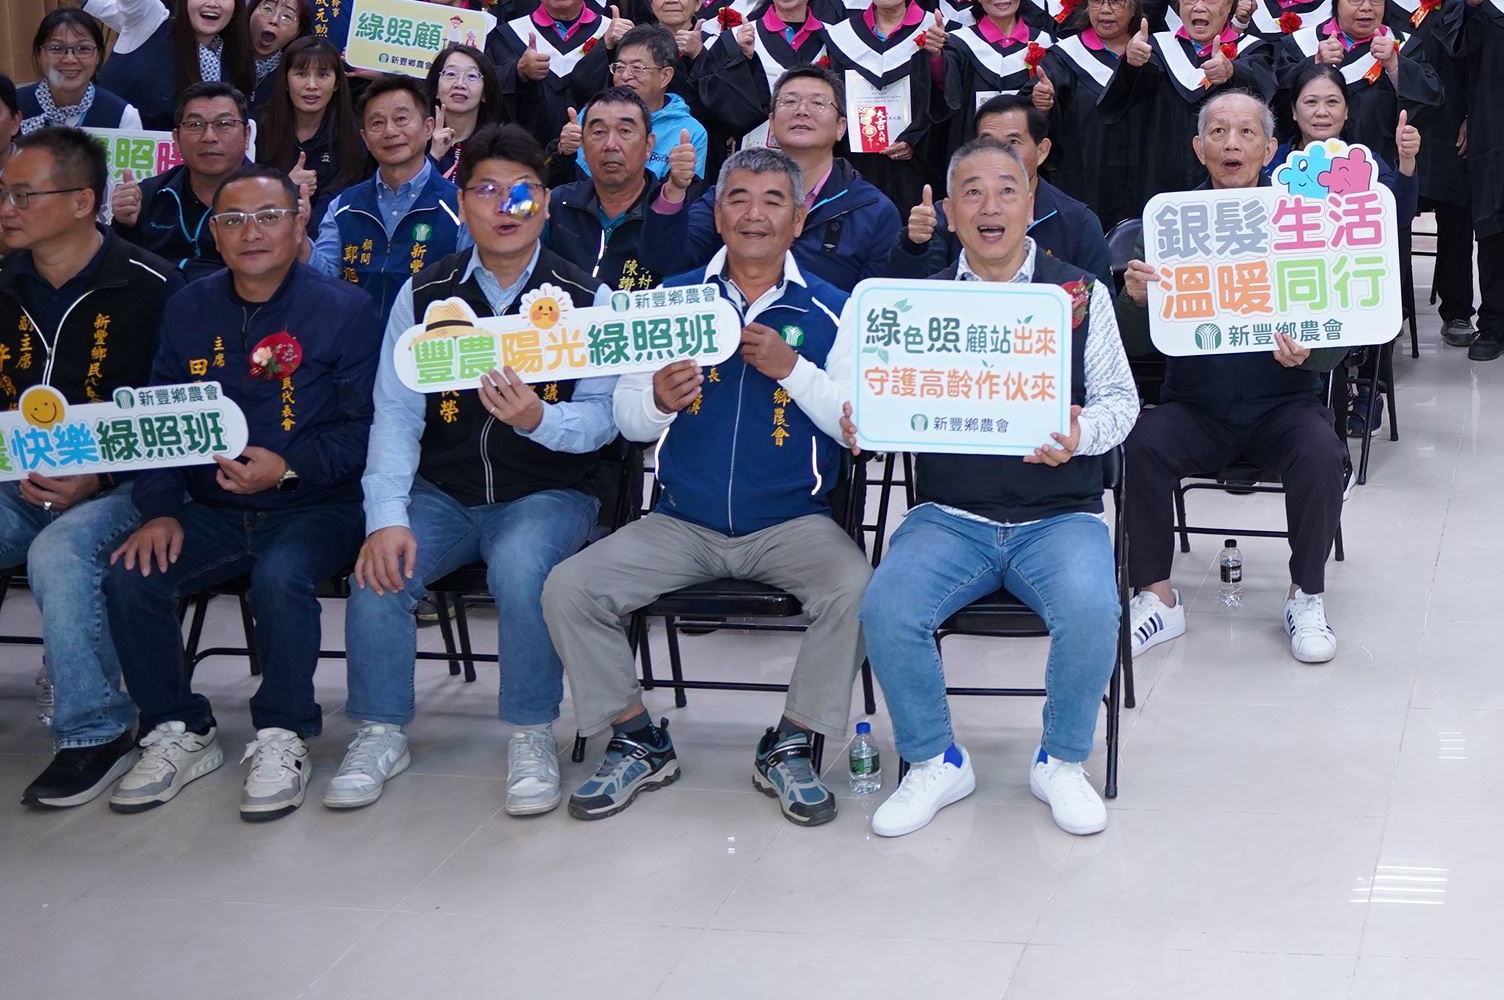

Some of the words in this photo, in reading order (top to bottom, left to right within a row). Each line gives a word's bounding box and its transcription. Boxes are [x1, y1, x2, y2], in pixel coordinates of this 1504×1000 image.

[355, 12, 444, 51] 綠照顧
[1154, 192, 1383, 259] 銀髮生活
[634, 286, 717, 310] 新豐鄉農會
[1158, 256, 1387, 319] 溫暖同行
[412, 312, 719, 386] 豐農陽光綠照班
[865, 306, 1057, 356] 綠色照顧站出來
[1227, 318, 1344, 348] 新豐鄉農會
[211, 336, 225, 369] 主席
[138, 383, 220, 408] 新豐鄉農會
[863, 365, 1057, 402] 守護高齡作伙來
[0, 411, 229, 473] 快樂綠照班
[932, 416, 1010, 433] 新豐鄉農會
